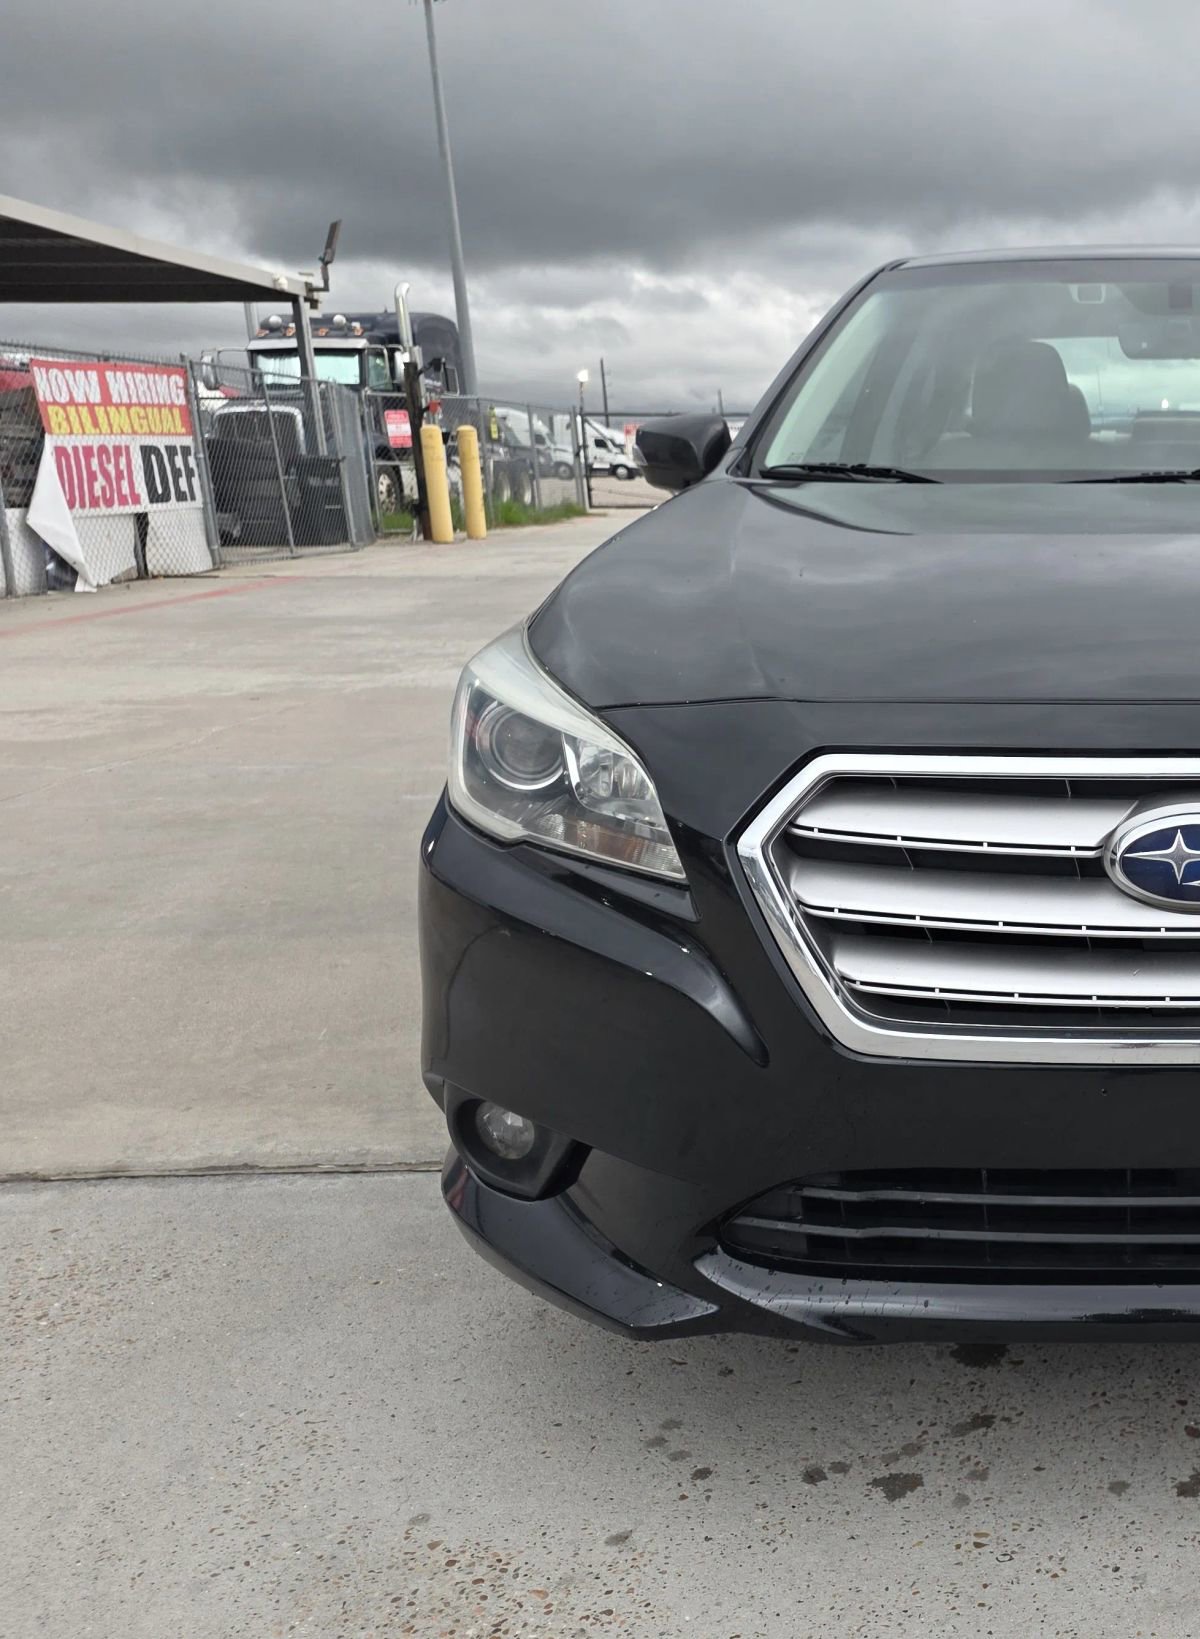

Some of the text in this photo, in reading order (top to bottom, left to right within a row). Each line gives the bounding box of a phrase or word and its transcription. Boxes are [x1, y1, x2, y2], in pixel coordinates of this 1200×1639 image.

[33, 366, 102, 404] NOW
[47, 404, 187, 435] BILINGUAL
[54, 443, 197, 511] DIESEL DEF
